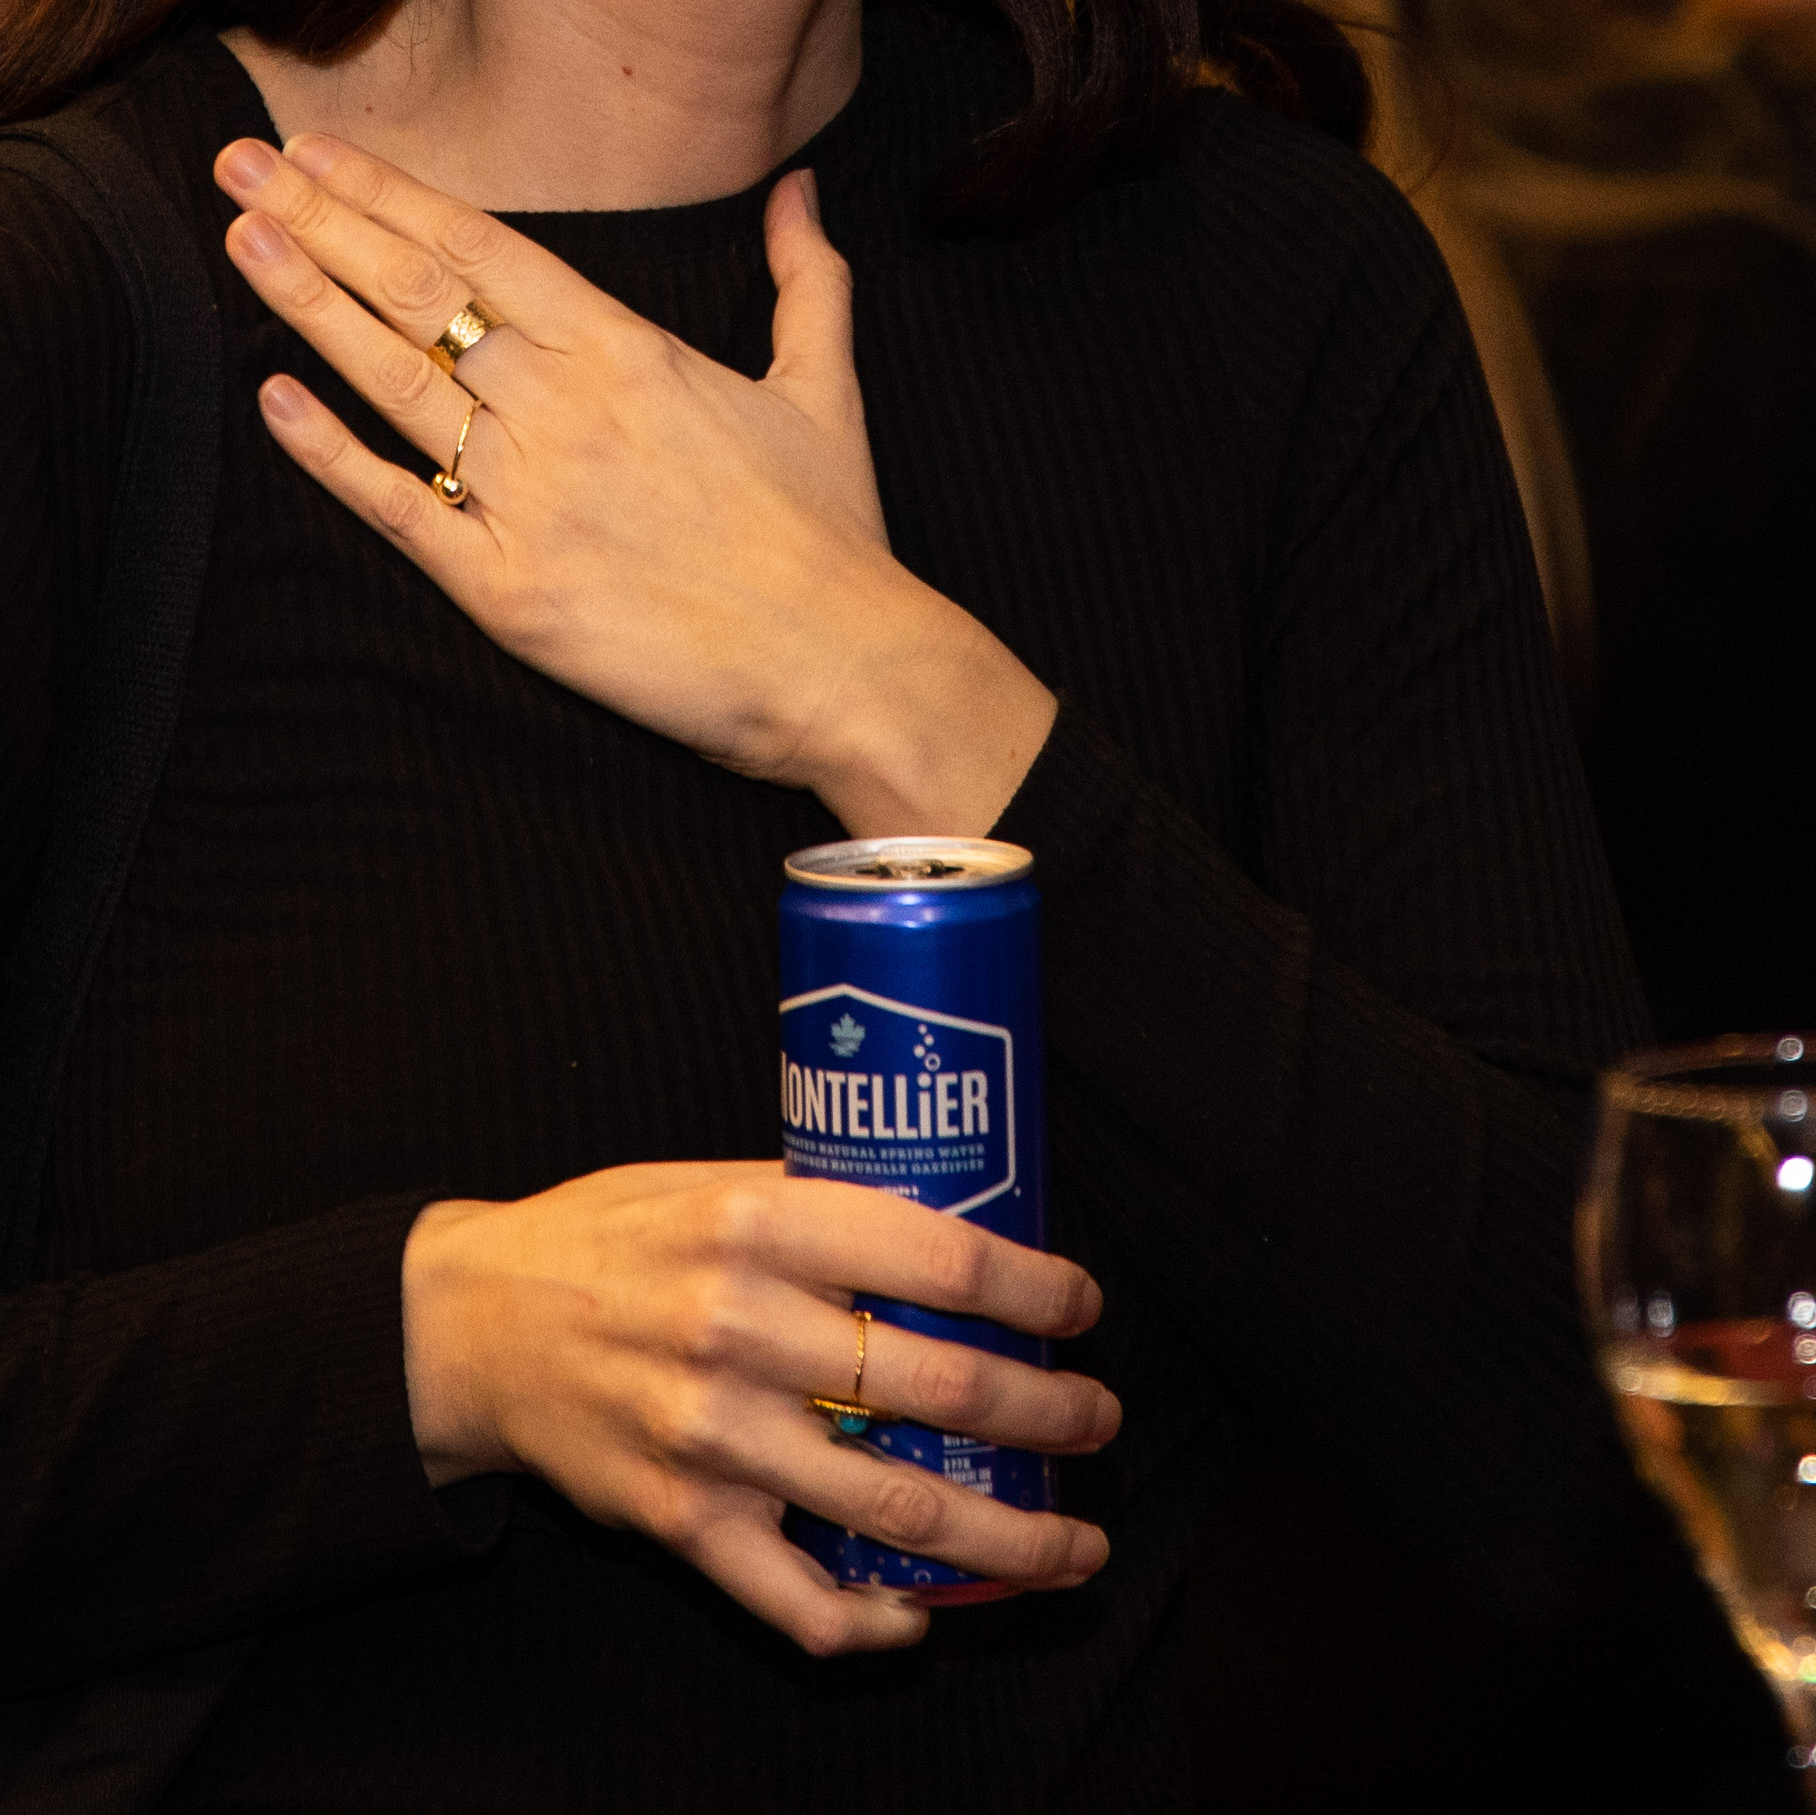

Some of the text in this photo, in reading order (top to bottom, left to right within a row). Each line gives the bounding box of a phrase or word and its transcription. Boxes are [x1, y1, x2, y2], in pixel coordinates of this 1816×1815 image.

[780, 1051, 988, 1138] ONTELLiER
[819, 1143, 984, 1160] NATURAL SPRING WATER
[830, 1159, 907, 1175] NATURELLE
